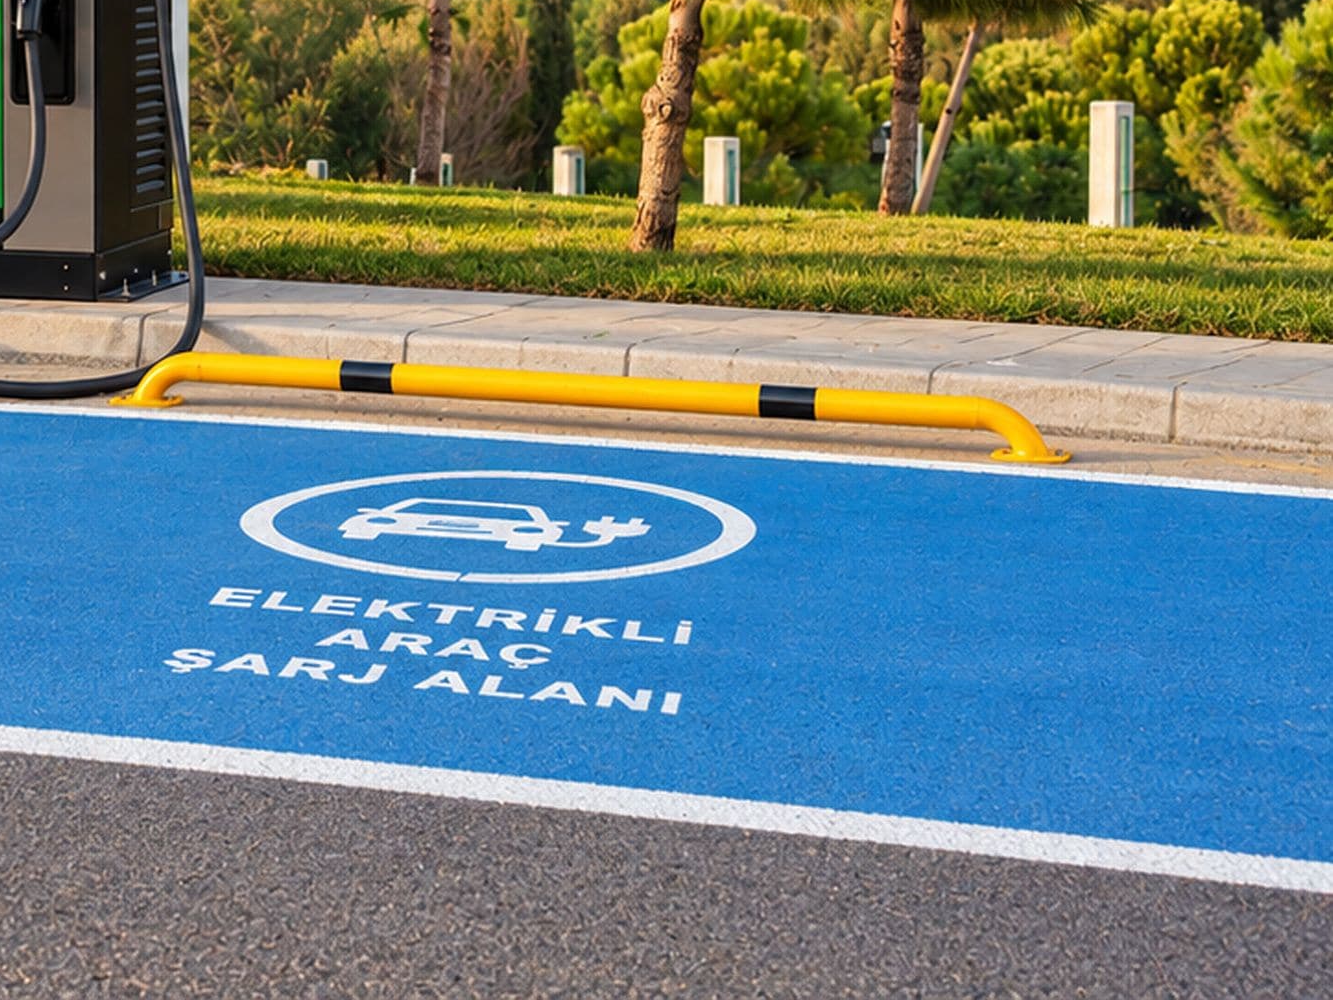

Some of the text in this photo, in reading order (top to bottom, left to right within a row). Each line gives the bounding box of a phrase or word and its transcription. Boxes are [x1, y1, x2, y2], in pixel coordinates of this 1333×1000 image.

[209, 587, 693, 645] ELEKTRİKLİ
[315, 628, 552, 670] ARAÇ
[164, 648, 682, 715] ŞARJ ALANI
